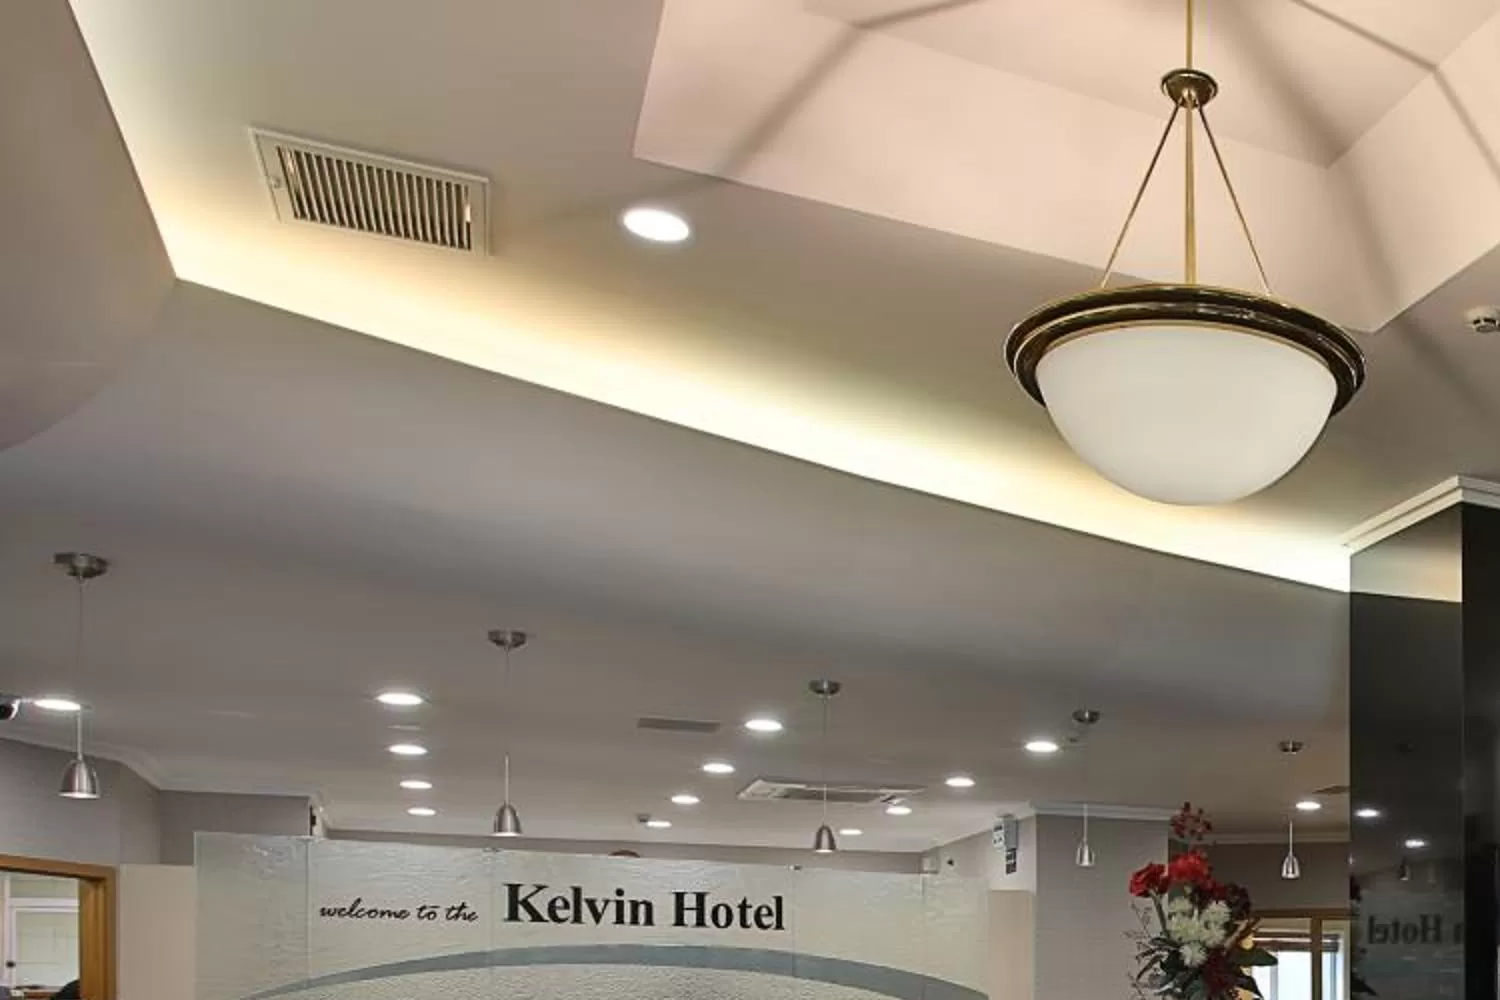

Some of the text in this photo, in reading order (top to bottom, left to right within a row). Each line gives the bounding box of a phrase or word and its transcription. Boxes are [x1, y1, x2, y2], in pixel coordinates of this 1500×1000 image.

[319, 883, 785, 930] welcome to the Kelvin Hotel
